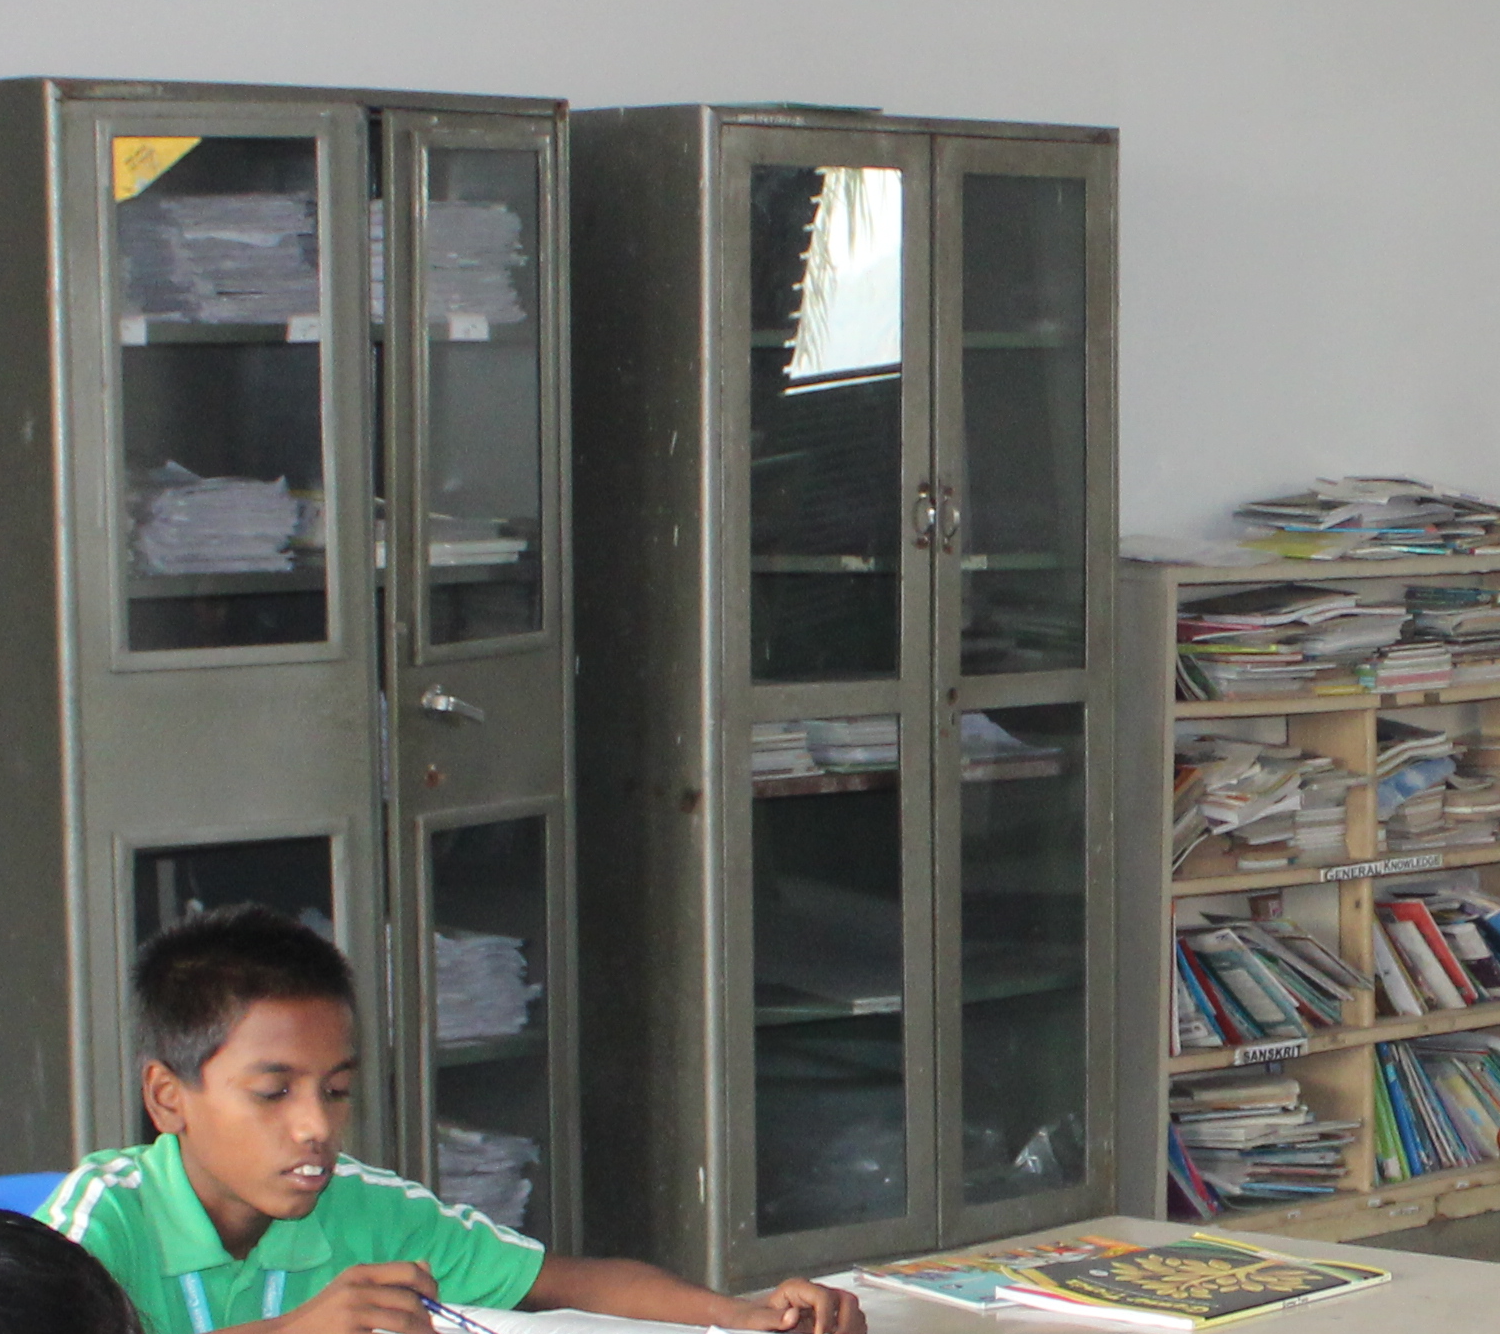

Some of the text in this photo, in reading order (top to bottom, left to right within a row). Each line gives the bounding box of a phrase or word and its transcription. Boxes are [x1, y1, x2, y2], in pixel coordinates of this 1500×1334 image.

[1325, 856, 1439, 881] GENERAL KNOWLEDGE
[1243, 1045, 1301, 1062] SANSKRIT
